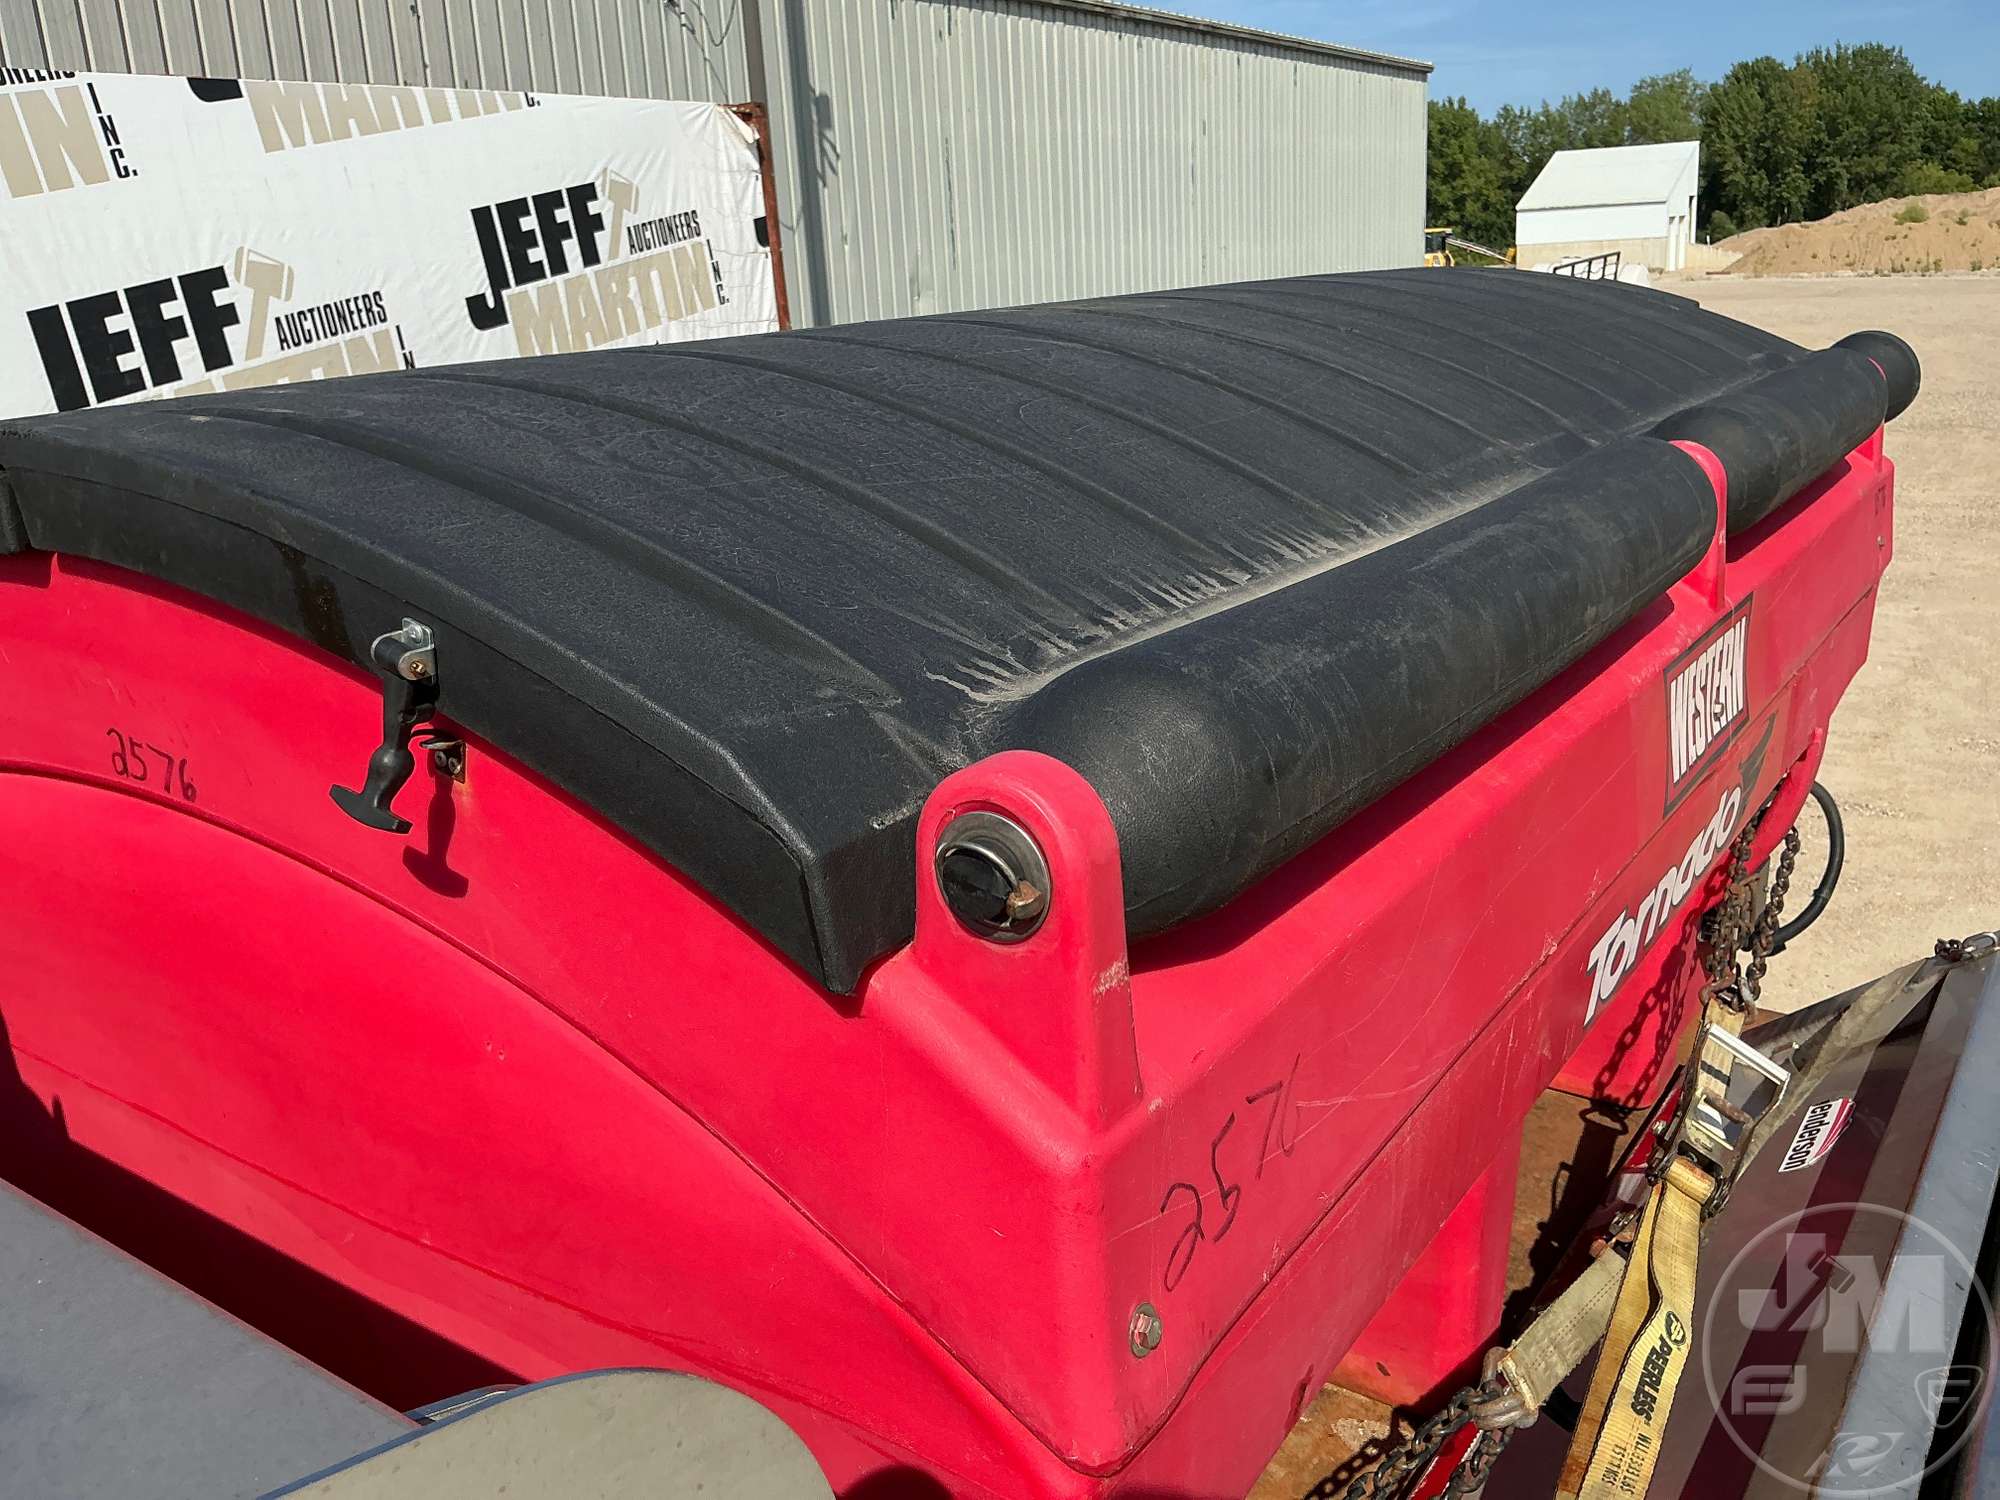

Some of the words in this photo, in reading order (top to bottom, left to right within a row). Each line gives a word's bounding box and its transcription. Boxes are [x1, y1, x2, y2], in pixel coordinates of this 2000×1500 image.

[86, 82, 138, 179] INC.
[465, 181, 605, 331] JEFF
[627, 209, 701, 254] AUCTIONEERS
[706, 238, 730, 306] INC.
[275, 290, 389, 351] AUCTIONEERS
[506, 240, 717, 358] MARTIN
[1670, 615, 1747, 784] WESTERN
[106, 727, 198, 803] 2576
[1583, 786, 1742, 1028] Tornado
[1631, 1333, 1673, 1422] PEERLESS
